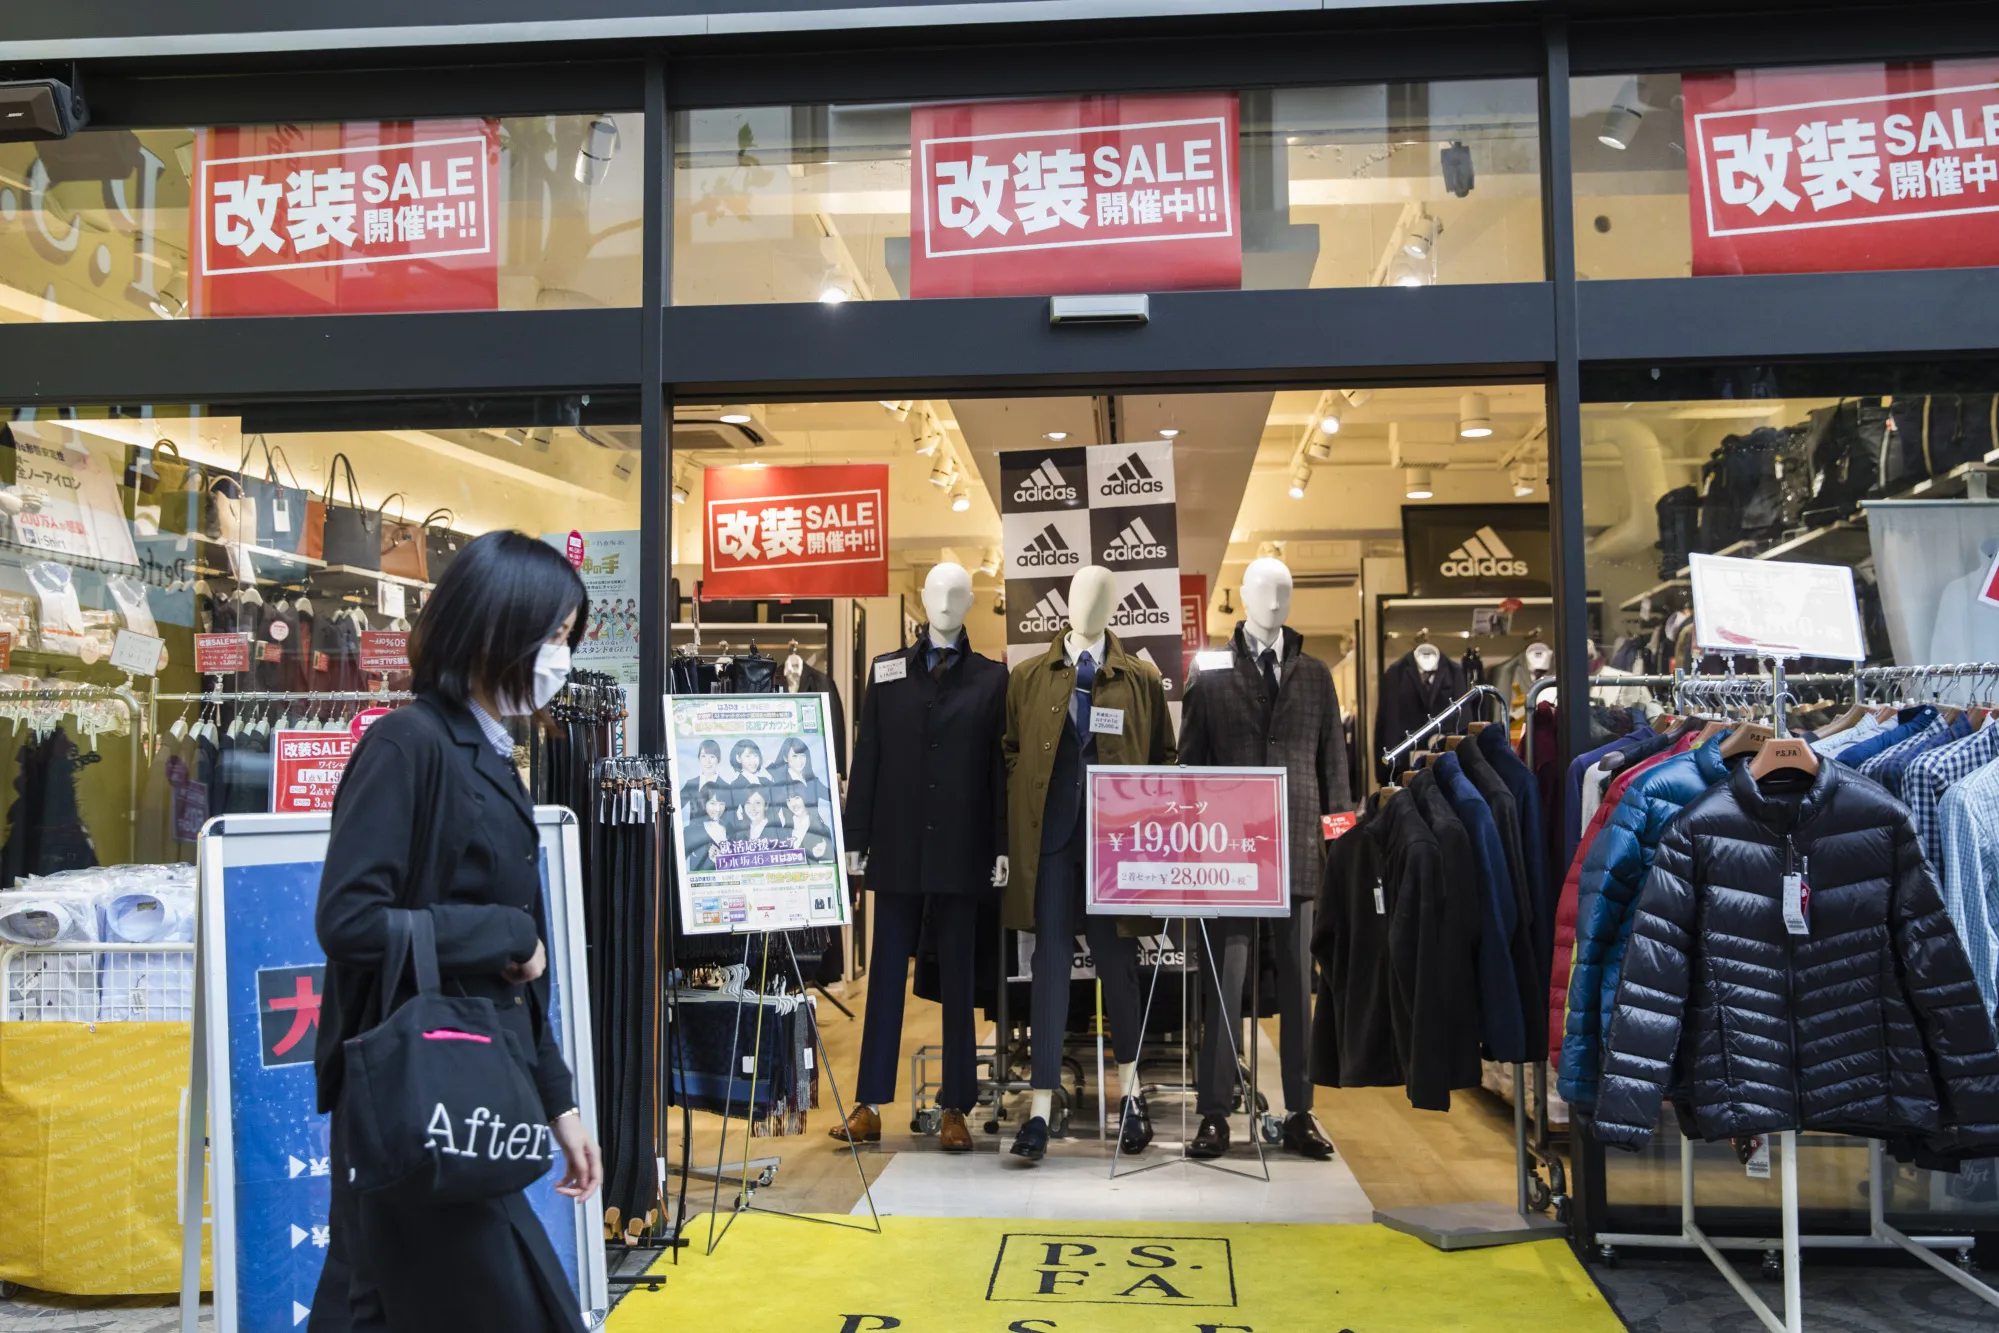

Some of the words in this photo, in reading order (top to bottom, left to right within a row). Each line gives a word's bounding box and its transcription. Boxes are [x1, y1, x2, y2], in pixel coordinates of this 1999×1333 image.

[1713, 117, 1884, 217] 改装
[936, 149, 1091, 239] 改装
[1093, 140, 1214, 187] SALE
[214, 168, 357, 257] 改装
[362, 157, 475, 204] SALE
[1013, 485, 1077, 503] adidas
[1100, 480, 1164, 497] adidas
[716, 506, 804, 562] 改装
[805, 502, 874, 530] SALE
[1016, 549, 1080, 567] adidas
[1103, 544, 1168, 562] adidas
[1440, 557, 1529, 578] adidas
[1164, 801, 1209, 816] スーツ
